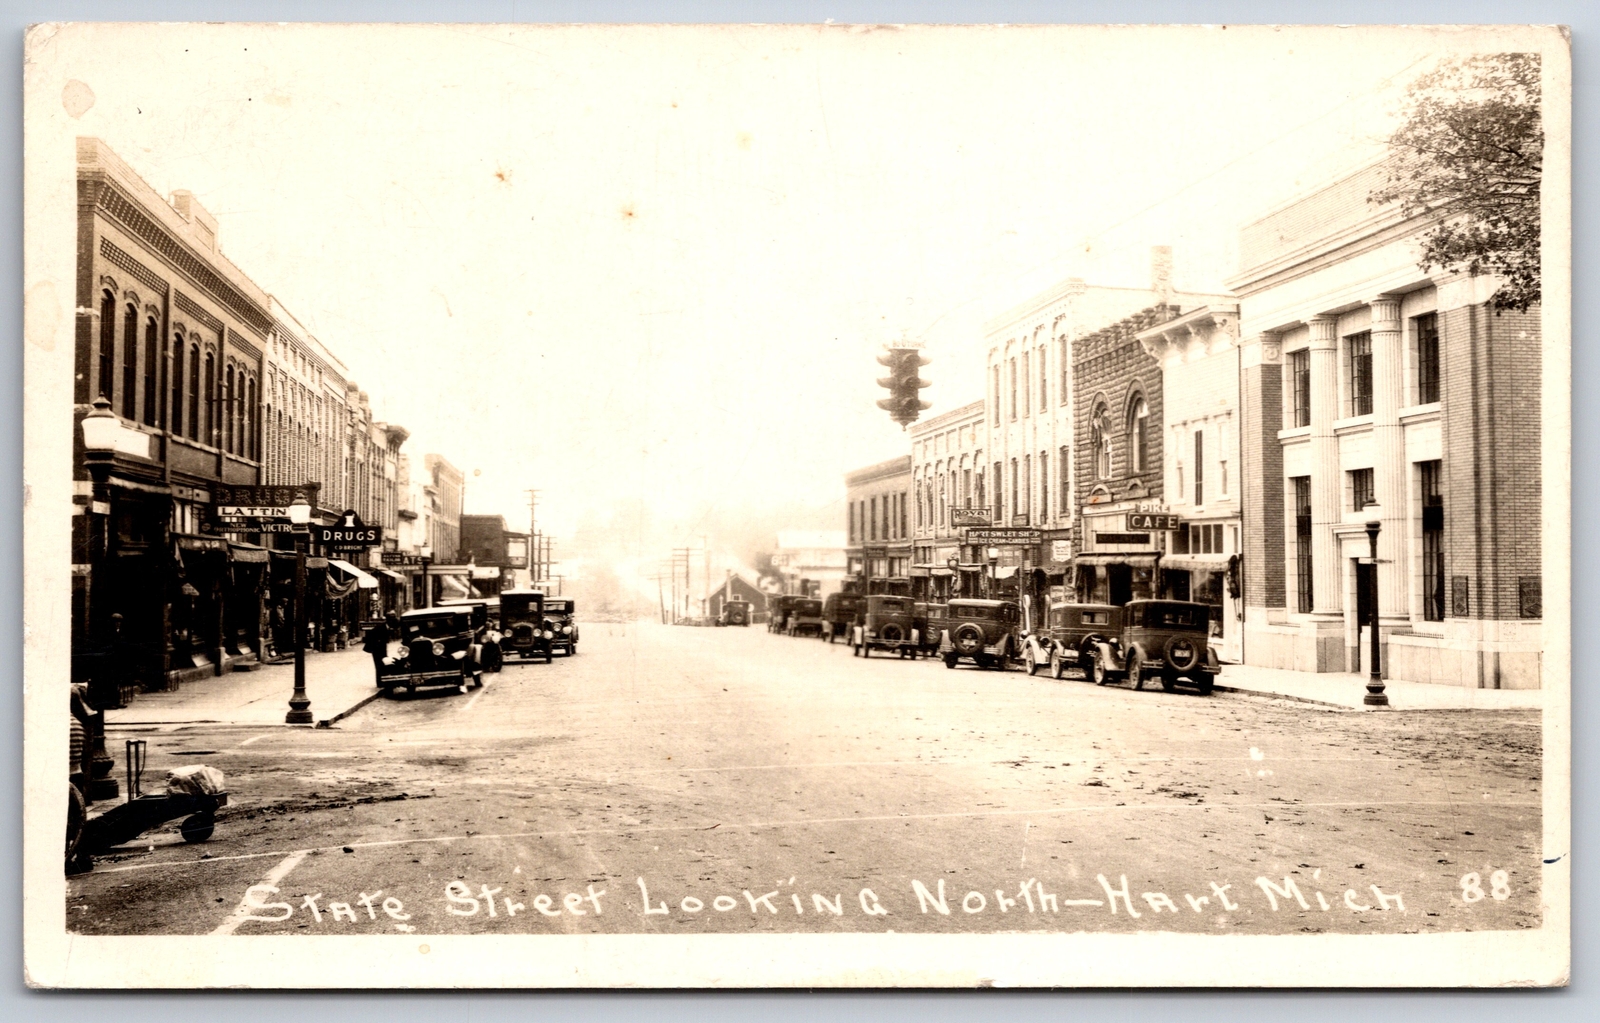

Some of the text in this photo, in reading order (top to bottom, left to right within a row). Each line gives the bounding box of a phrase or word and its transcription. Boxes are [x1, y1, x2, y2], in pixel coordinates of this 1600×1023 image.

[222, 507, 287, 516] LATTIN
[1140, 504, 1169, 513] PIKE
[1131, 516, 1177, 529] CAFE
[323, 530, 376, 541] DRUGS
